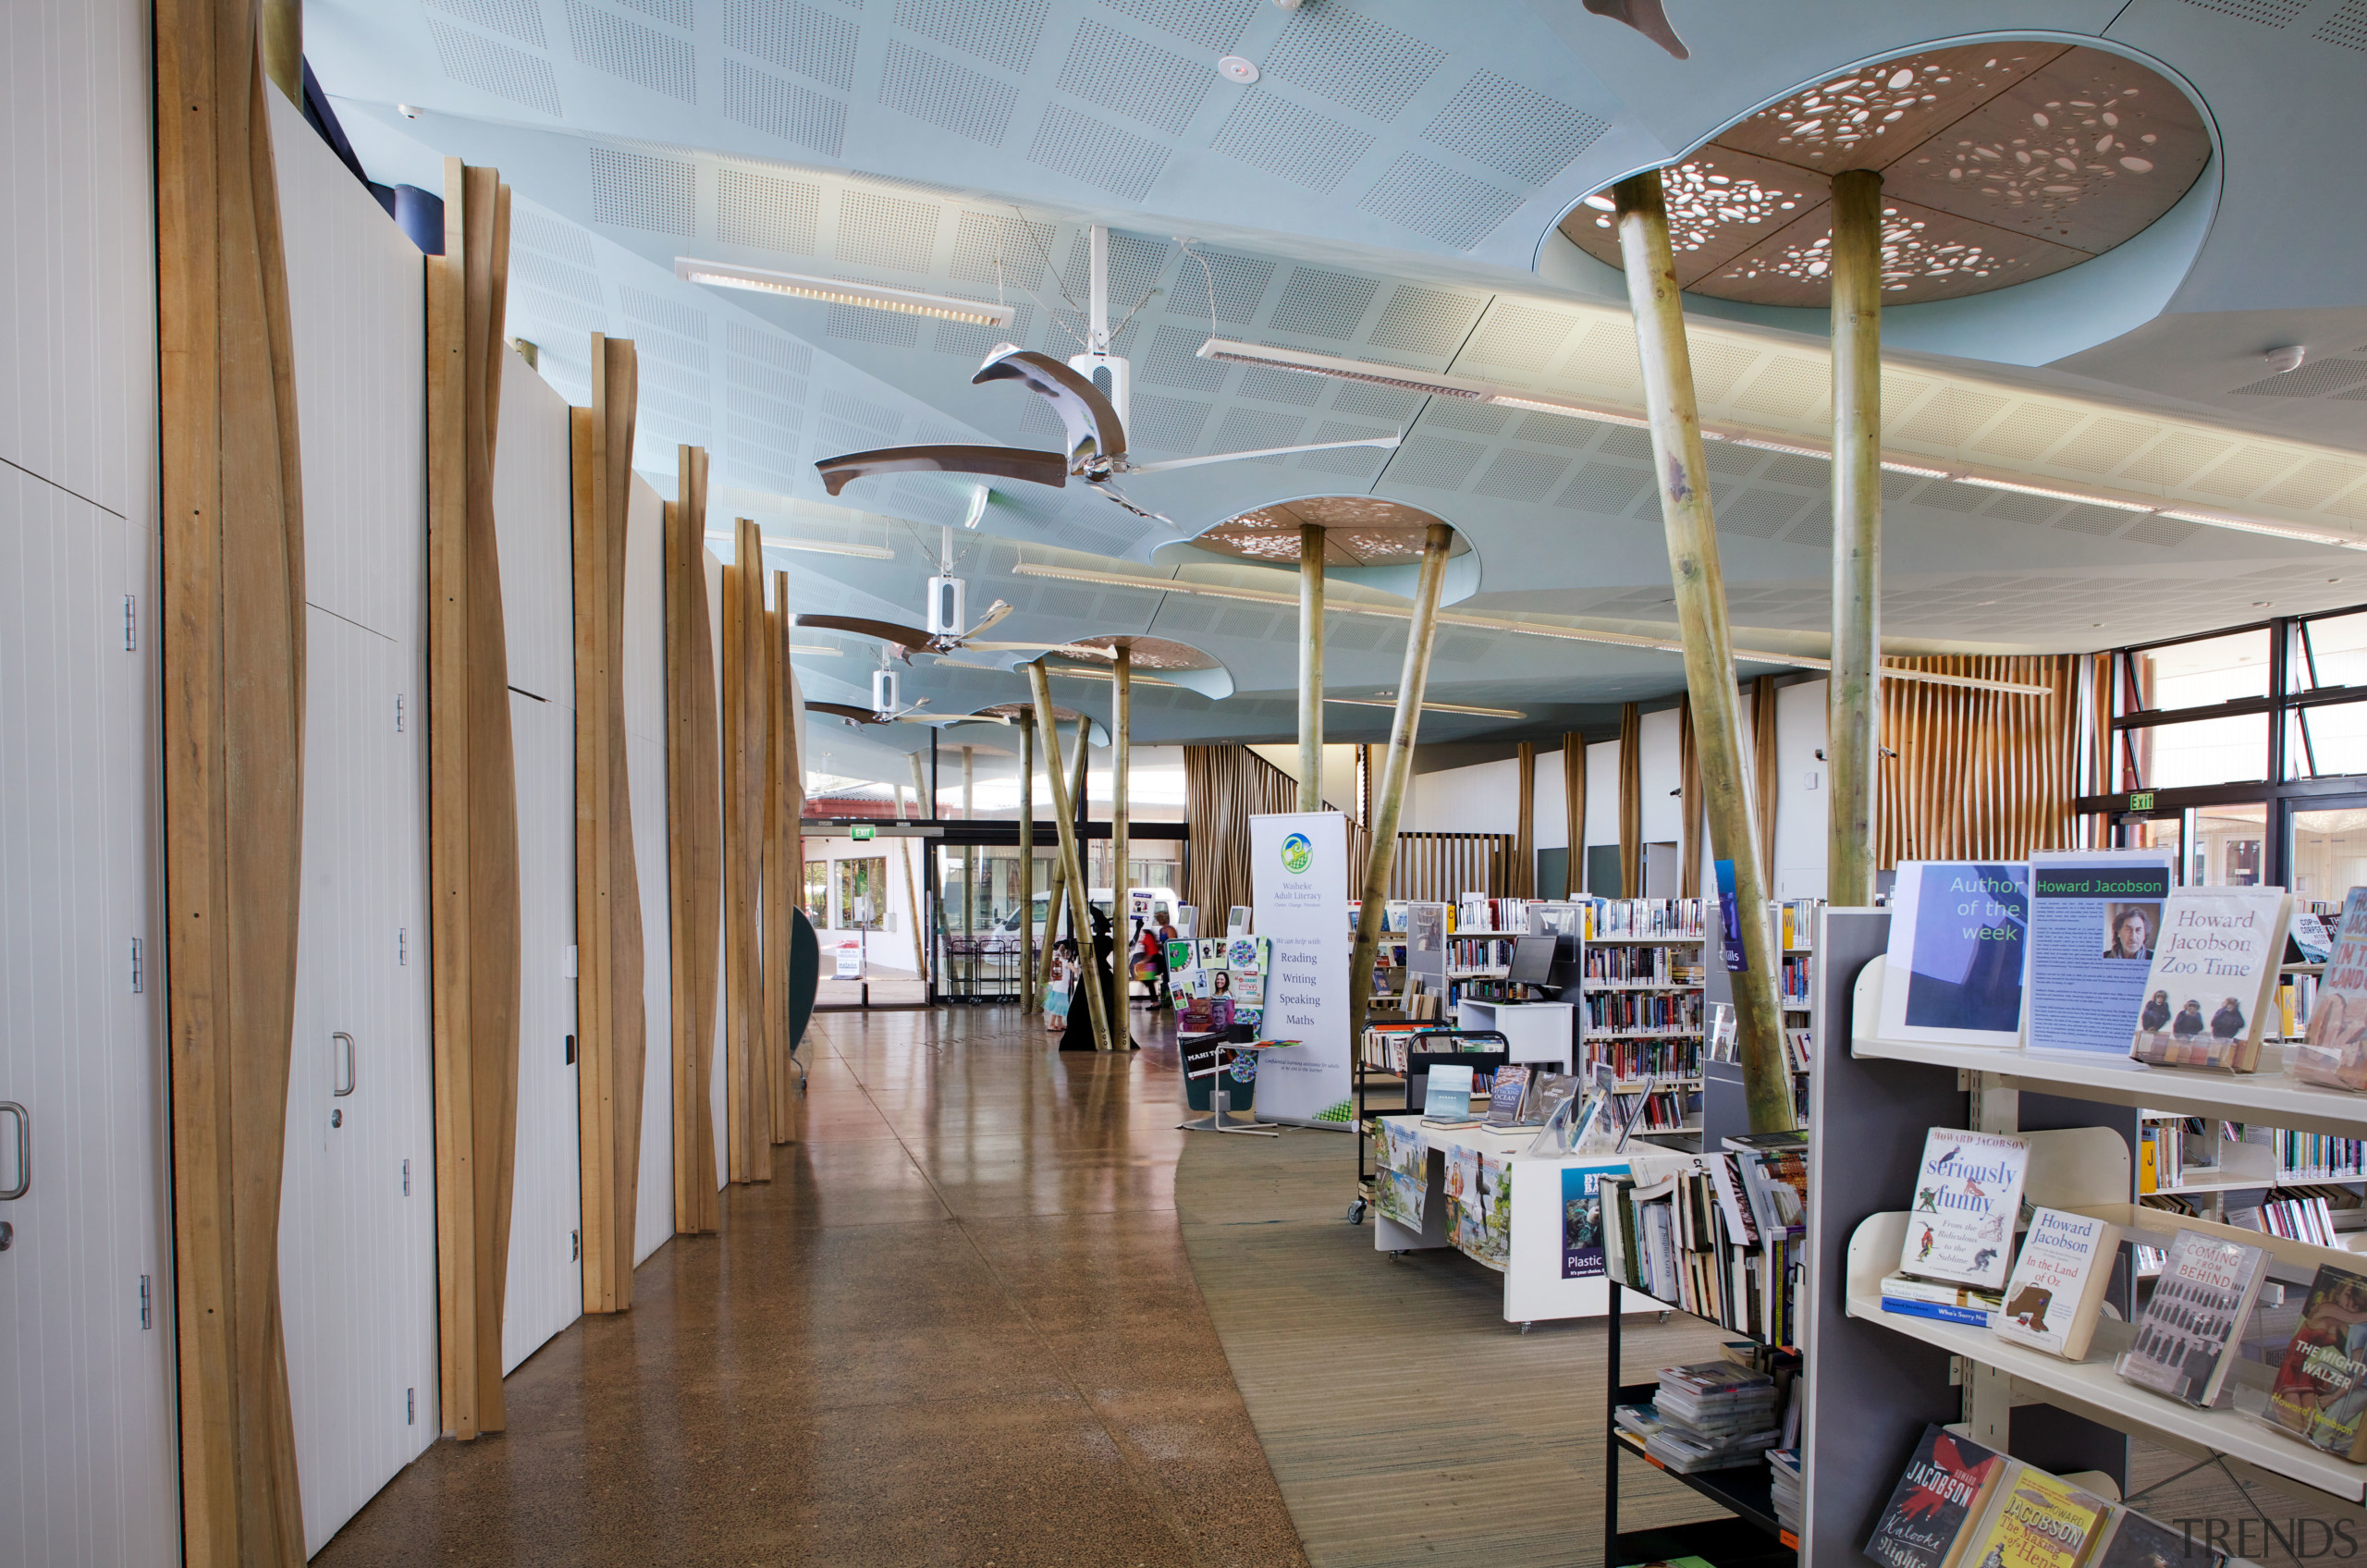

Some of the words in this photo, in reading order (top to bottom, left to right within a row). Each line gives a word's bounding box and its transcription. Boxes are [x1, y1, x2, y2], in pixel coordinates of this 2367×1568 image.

[2132, 795, 2152, 809] Exit
[855, 828, 871, 837] EXIT
[1950, 877, 2024, 893] Author
[2037, 880, 2090, 893] Howard
[2094, 880, 2162, 893] Jacobson
[1294, 892, 1322, 901] Literacy
[1957, 900, 1980, 916] of
[1986, 900, 2020, 917] the
[1784, 914, 1794, 928] W
[2177, 910, 2255, 928] Howard
[2300, 918, 2312, 926] COP
[1962, 925, 2018, 941] week
[2165, 933, 2251, 953] Jacobson
[1281, 952, 1318, 965] Reading
[2336, 942, 2357, 965] IN
[2160, 957, 2198, 974] Zoo
[2204, 958, 2250, 977] Time
[1282, 973, 1317, 986] Writing
[2328, 967, 2364, 990] LAND
[1280, 993, 1320, 1007] Speaking
[1286, 1014, 1315, 1025] Maths
[1187, 1051, 1209, 1061] MAHI
[1933, 1131, 1973, 1144] HOWARD
[1975, 1136, 2026, 1150] JACOBSON
[2147, 1149, 2154, 1167] J
[1926, 1157, 2018, 1193] seriously
[1936, 1184, 1995, 1220] funny
[1942, 1219, 1963, 1231] From
[1965, 1220, 1978, 1231] the
[2041, 1213, 2093, 1237] Howard
[1937, 1230, 1978, 1243] Ridiculous
[2031, 1229, 2089, 1254] Jacobson
[1954, 1243, 1967, 1253] the
[2187, 1243, 2239, 1267] COMING
[1568, 1255, 1602, 1268] Plastic
[1937, 1253, 1968, 1265] Sublime
[2027, 1256, 2036, 1267] In
[2039, 1258, 2053, 1271] the
[2054, 1263, 2079, 1278] Land
[2195, 1259, 2222, 1272] FROM
[2035, 1272, 2045, 1282] of
[2047, 1275, 2061, 1287] Oz
[2178, 1264, 2231, 1288] BEHIND
[1906, 1303, 1929, 1312] Jacobson
[1938, 1308, 1956, 1317] Who's
[1957, 1311, 1974, 1321] Sorry
[2296, 1340, 2321, 1357] THE
[2319, 1350, 2367, 1377] MIGHTY
[2301, 1360, 2352, 1390] WALZER
[2271, 1392, 2311, 1417] Howard
[1907, 1461, 1973, 1508] JACOBSON
[1954, 1468, 1977, 1486] HOWARD
[2004, 1496, 2084, 1550] JACOBSON
[2045, 1503, 2084, 1527] HOWARD
[1880, 1513, 1944, 1550] Kalooki
[2000, 1514, 2019, 1534] The
[2020, 1525, 2062, 1560] Making
